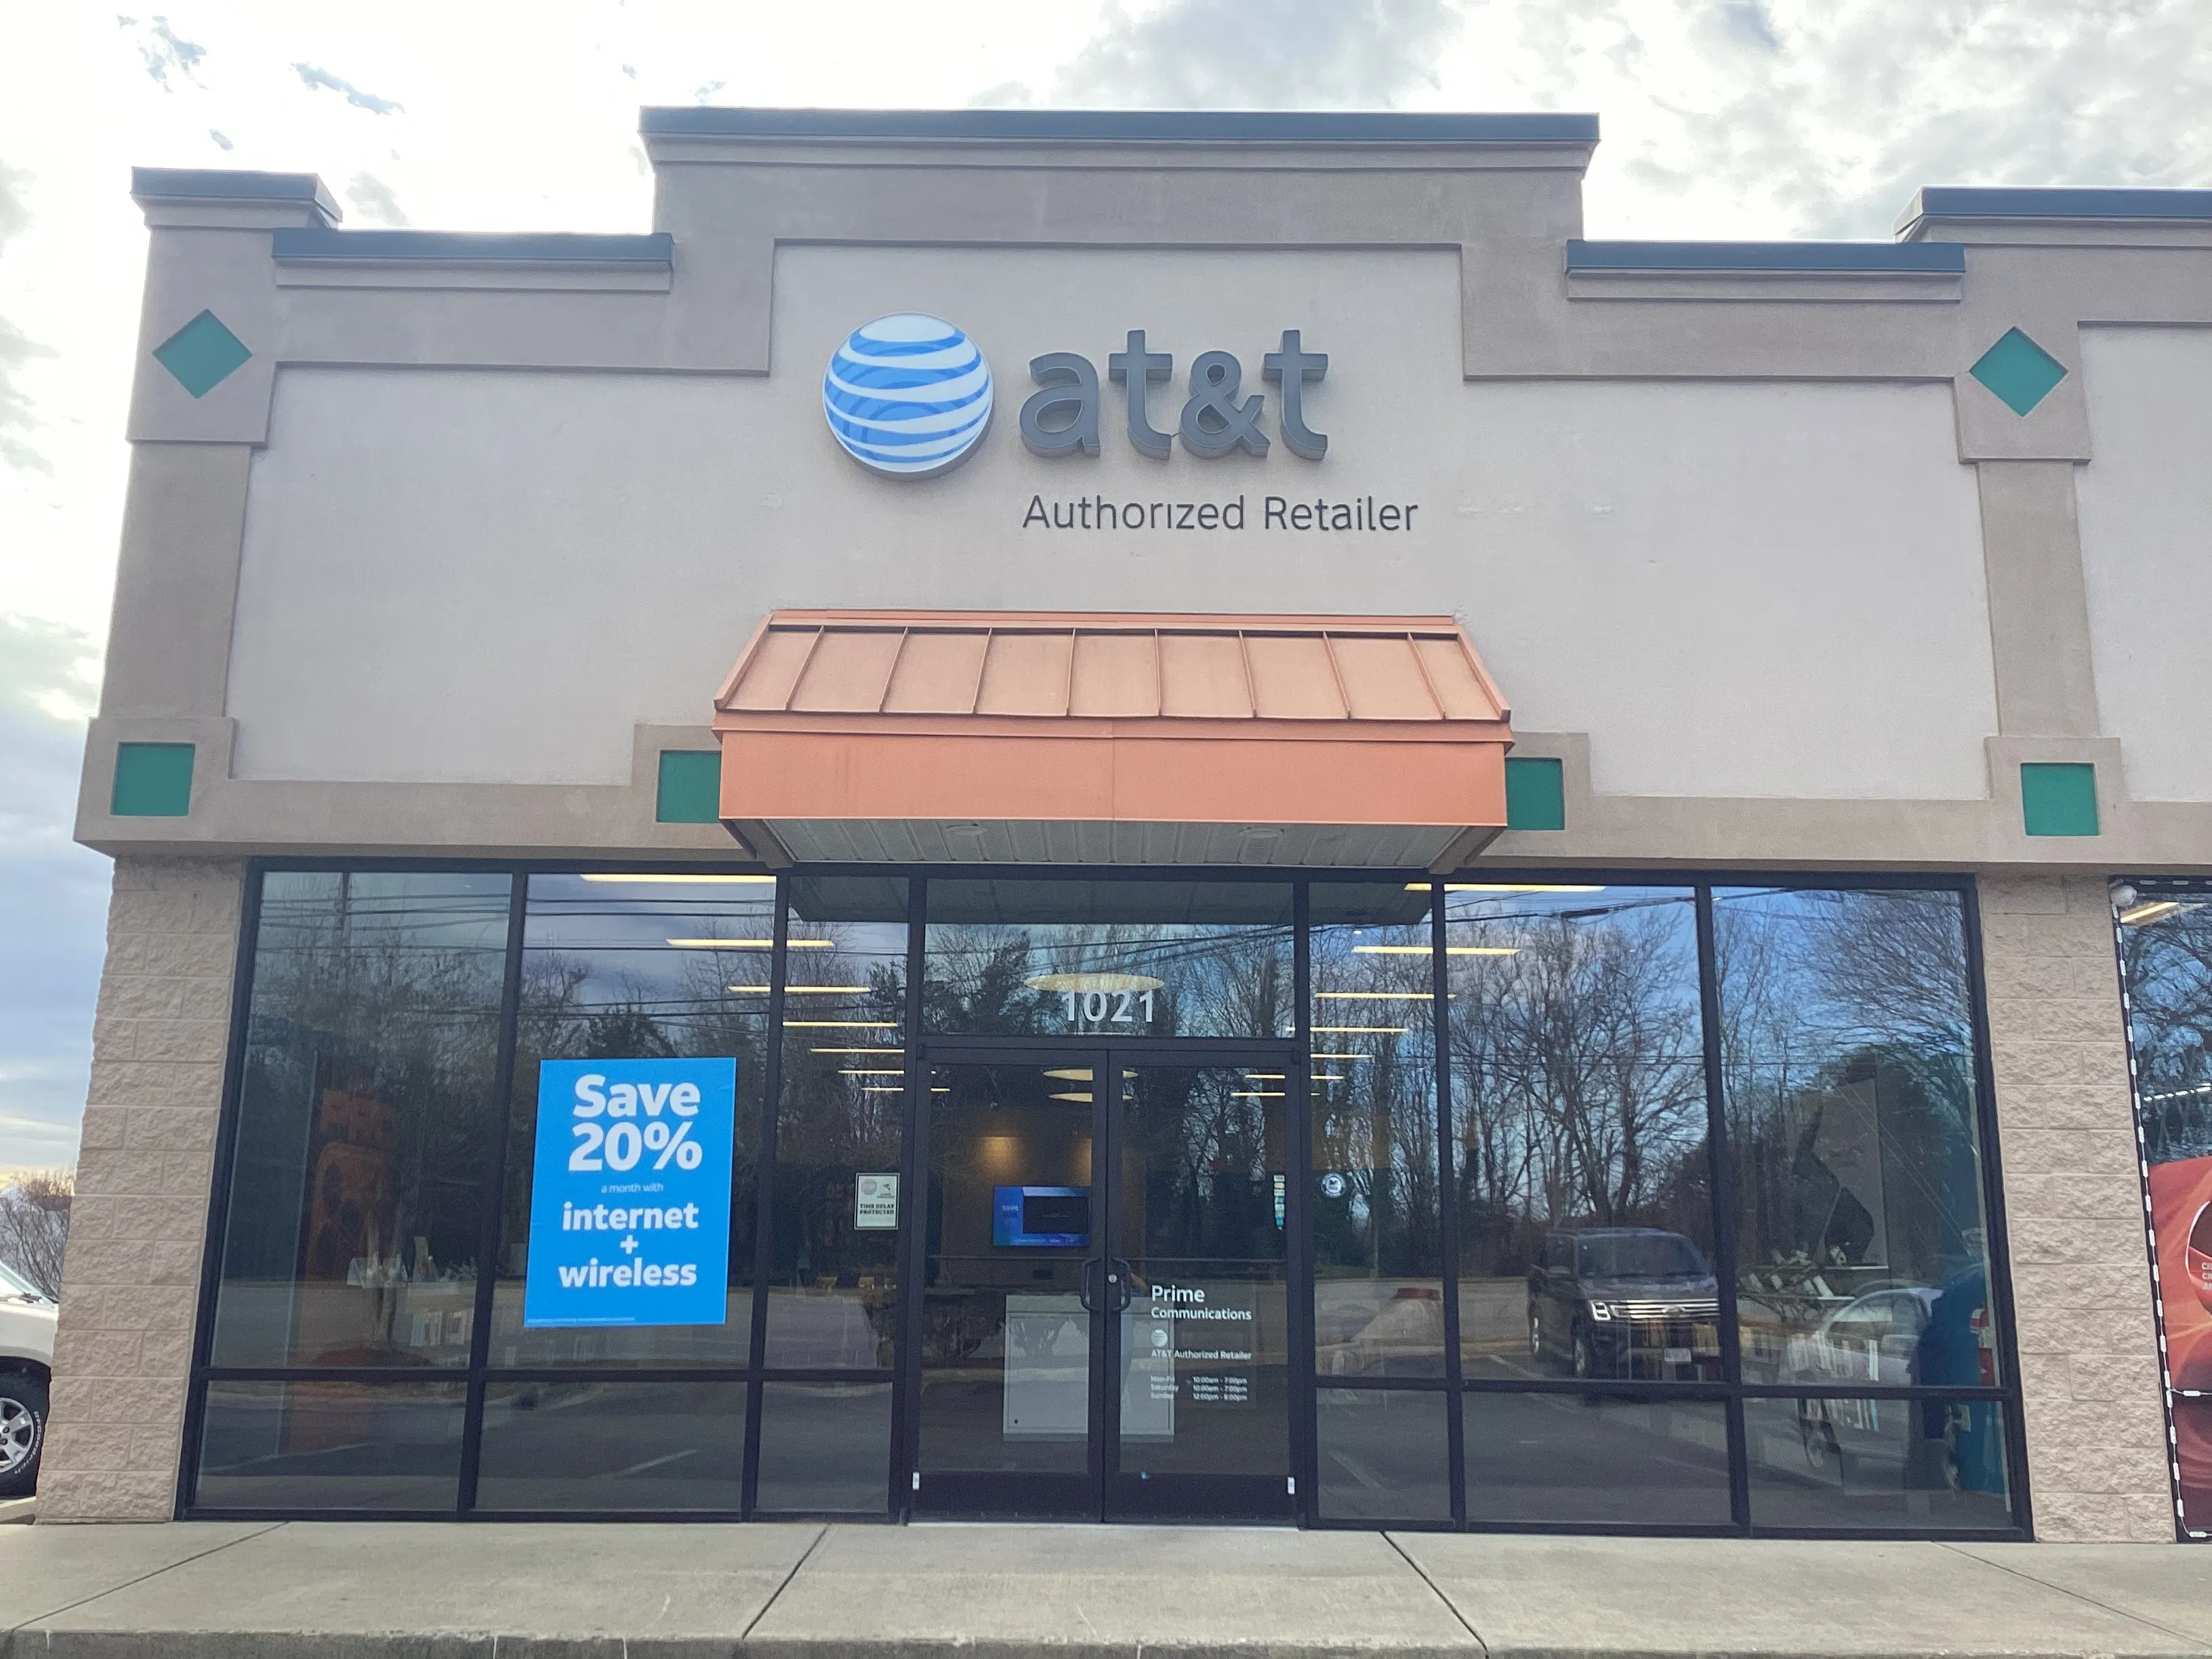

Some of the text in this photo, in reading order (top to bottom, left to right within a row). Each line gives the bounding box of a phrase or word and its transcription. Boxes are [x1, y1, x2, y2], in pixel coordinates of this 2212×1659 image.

[1019, 329, 1328, 462] at&t
[1022, 495, 1418, 532] Authorized Retailer
[1061, 989, 1153, 1022] 1021
[573, 1073, 701, 1118] Save
[569, 1122, 703, 1172] 20%
[601, 1182, 664, 1193] a month with
[562, 1201, 699, 1231] internet
[620, 1234, 638, 1254] +
[558, 1257, 697, 1288] wireless
[1152, 1285, 1205, 1303] Prime
[1151, 1307, 1252, 1320] Communications
[1174, 1350, 1218, 1359] Authorized
[1221, 1351, 1252, 1360] Retailer
